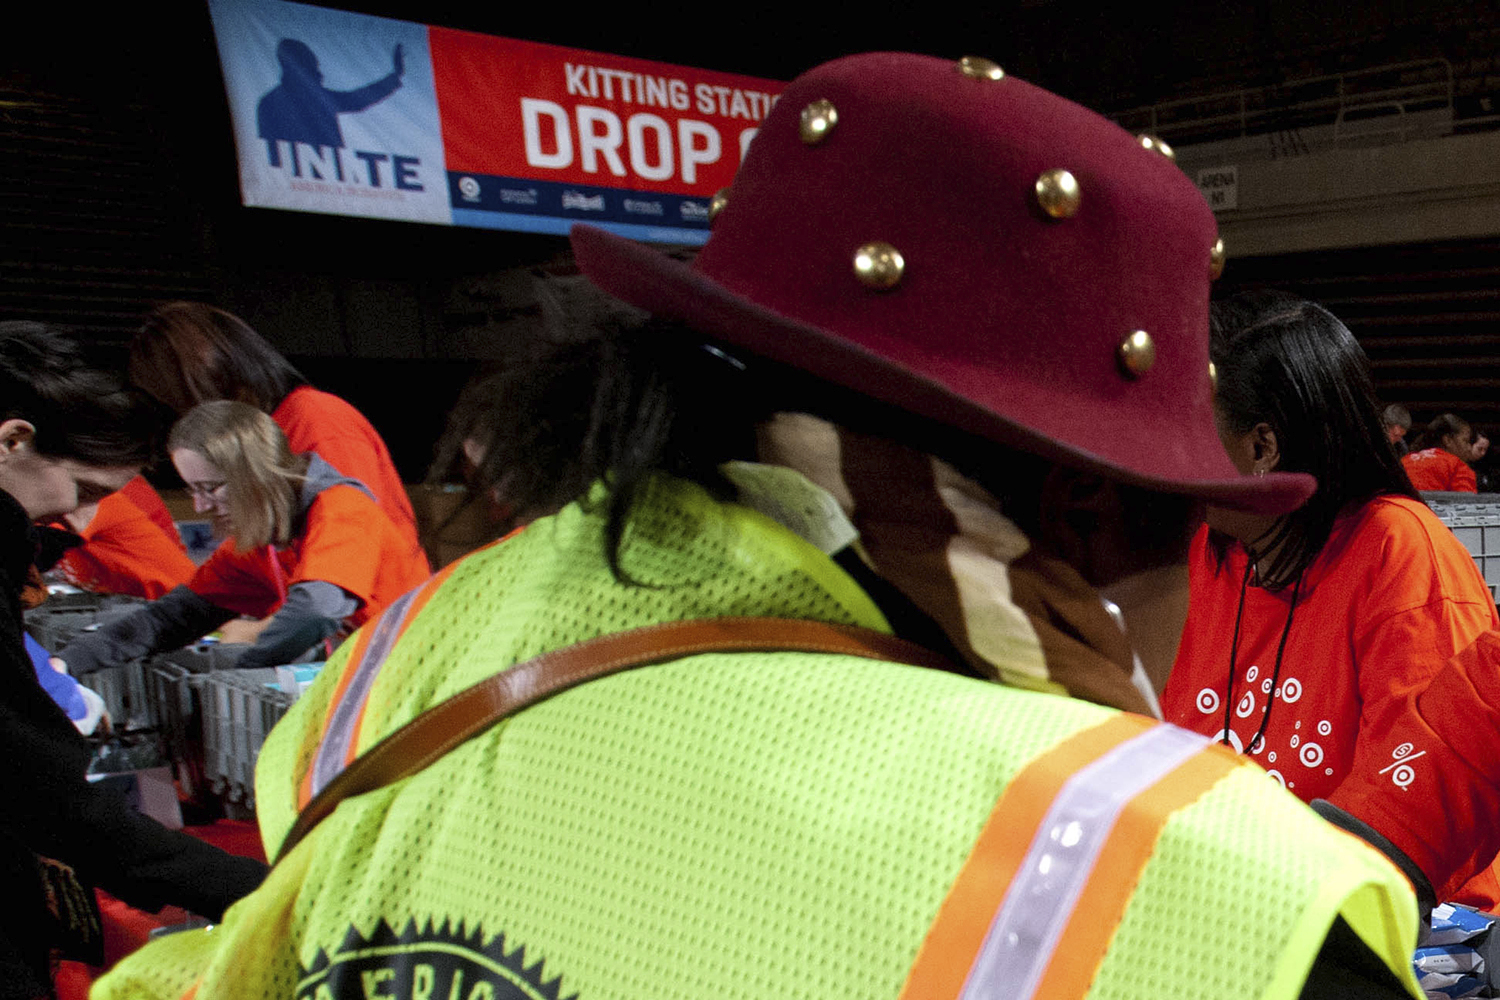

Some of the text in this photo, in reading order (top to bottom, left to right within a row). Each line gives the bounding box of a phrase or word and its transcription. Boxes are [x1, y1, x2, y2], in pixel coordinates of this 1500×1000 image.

[564, 62, 691, 111] KITTING
[520, 97, 722, 185] DROP
[1201, 172, 1235, 188] ARENA
